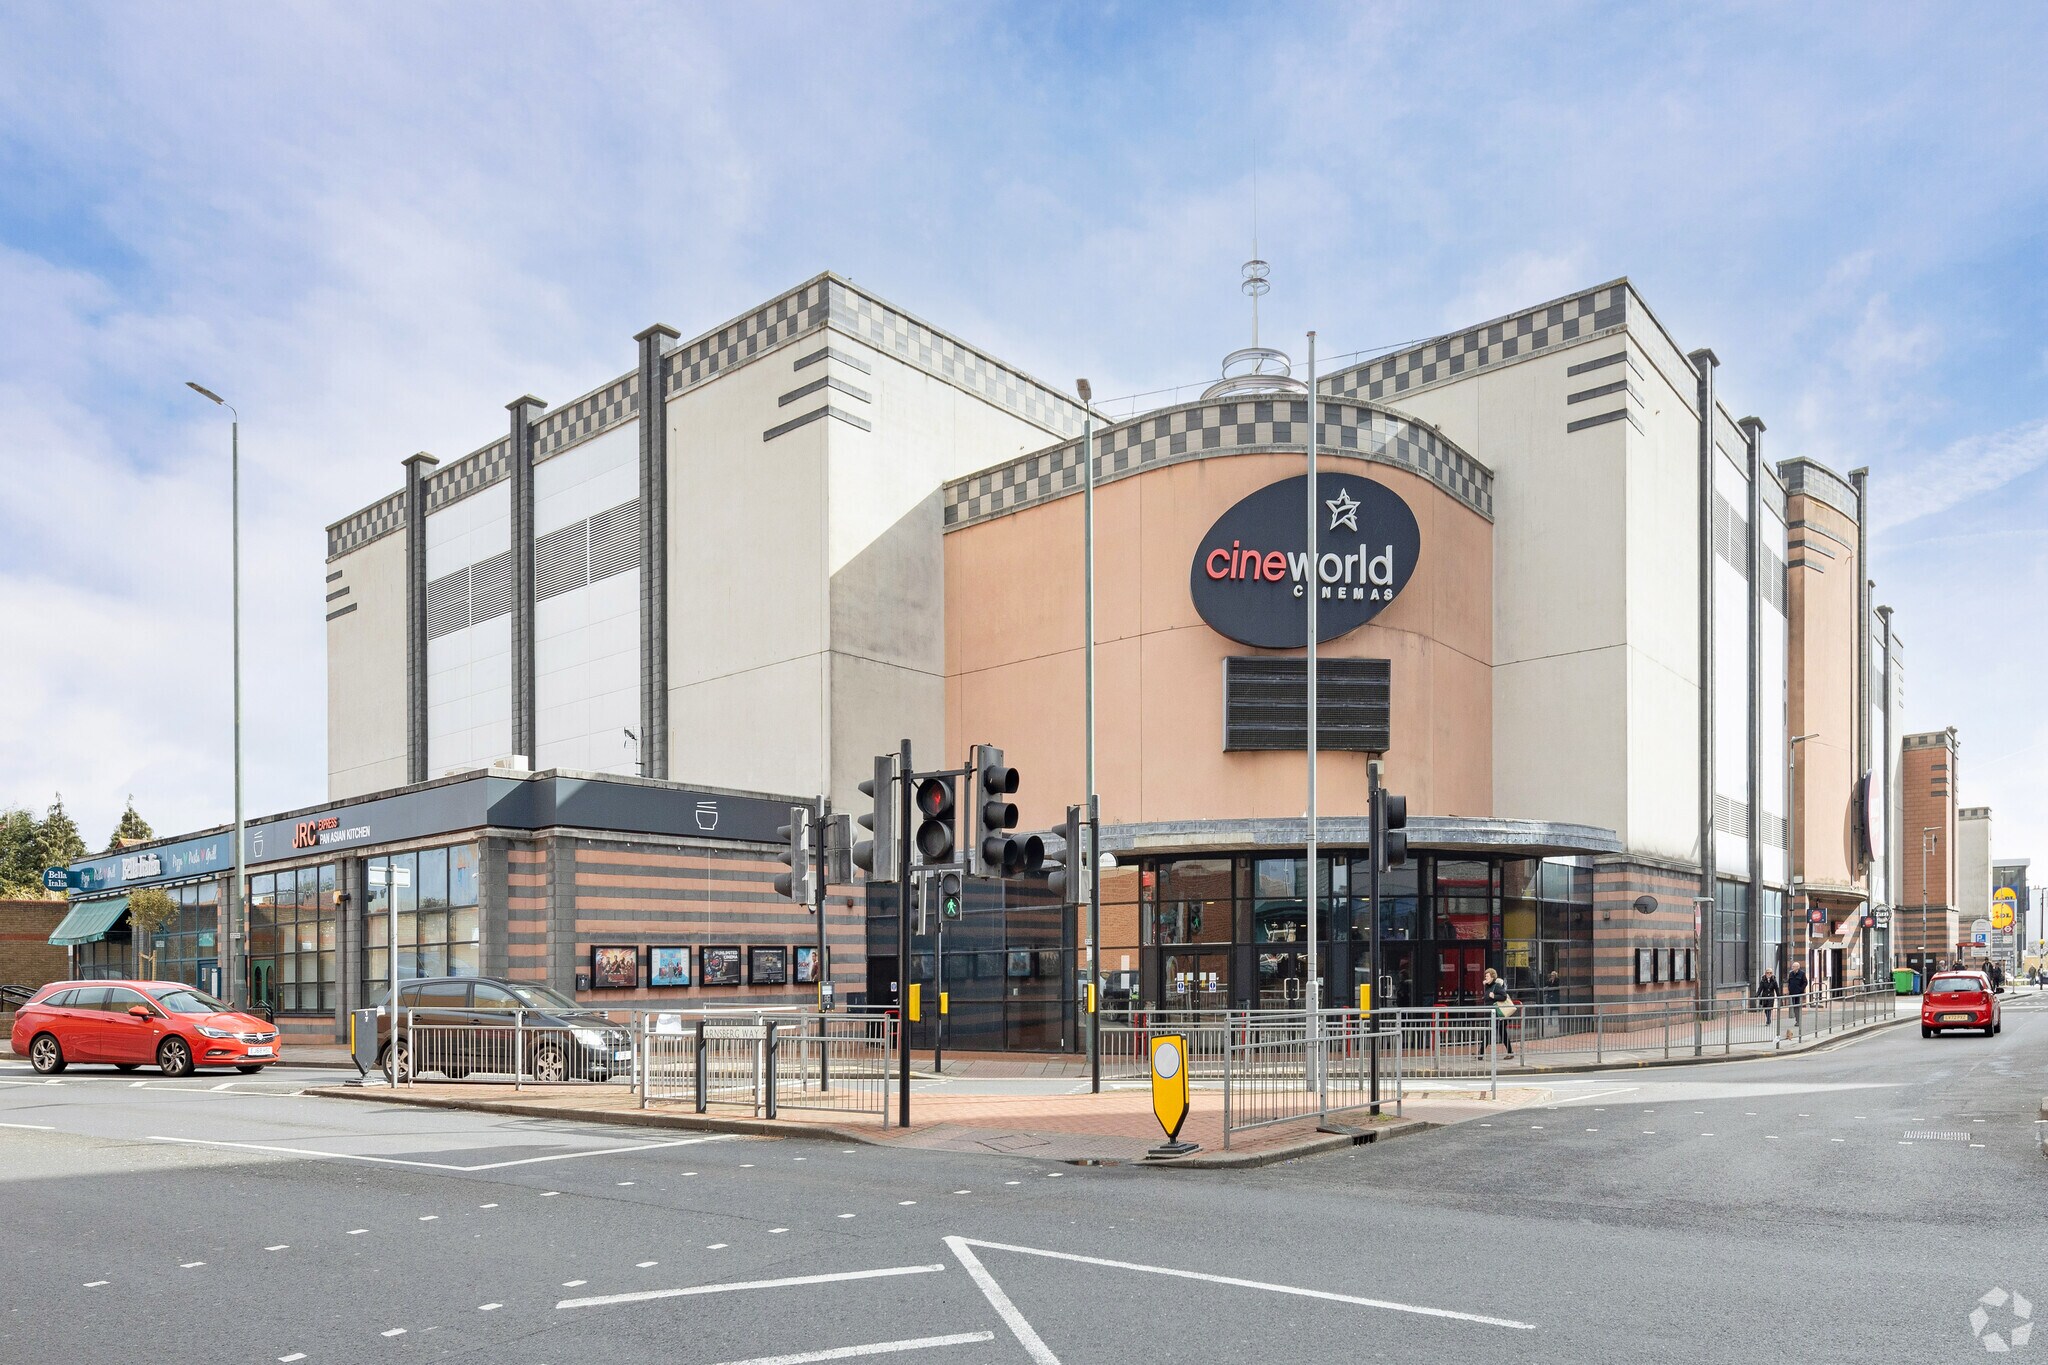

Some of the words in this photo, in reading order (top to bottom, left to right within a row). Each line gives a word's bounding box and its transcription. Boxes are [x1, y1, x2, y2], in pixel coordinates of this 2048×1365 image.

[1206, 540, 1393, 585] cineworld
[1293, 584, 1393, 601] CNEMAS
[318, 816, 338, 831] EXPRESS
[292, 820, 316, 848] JRC
[319, 832, 330, 845] PAN
[330, 830, 346, 843] ASIAN
[346, 825, 371, 840] KITCHEN
[47, 871, 68, 879] Bella
[47, 879, 68, 887] Italia
[1977, 934, 1983, 942] P
[704, 1029, 740, 1038] ARNSBERG
[742, 1029, 759, 1038] WAY
